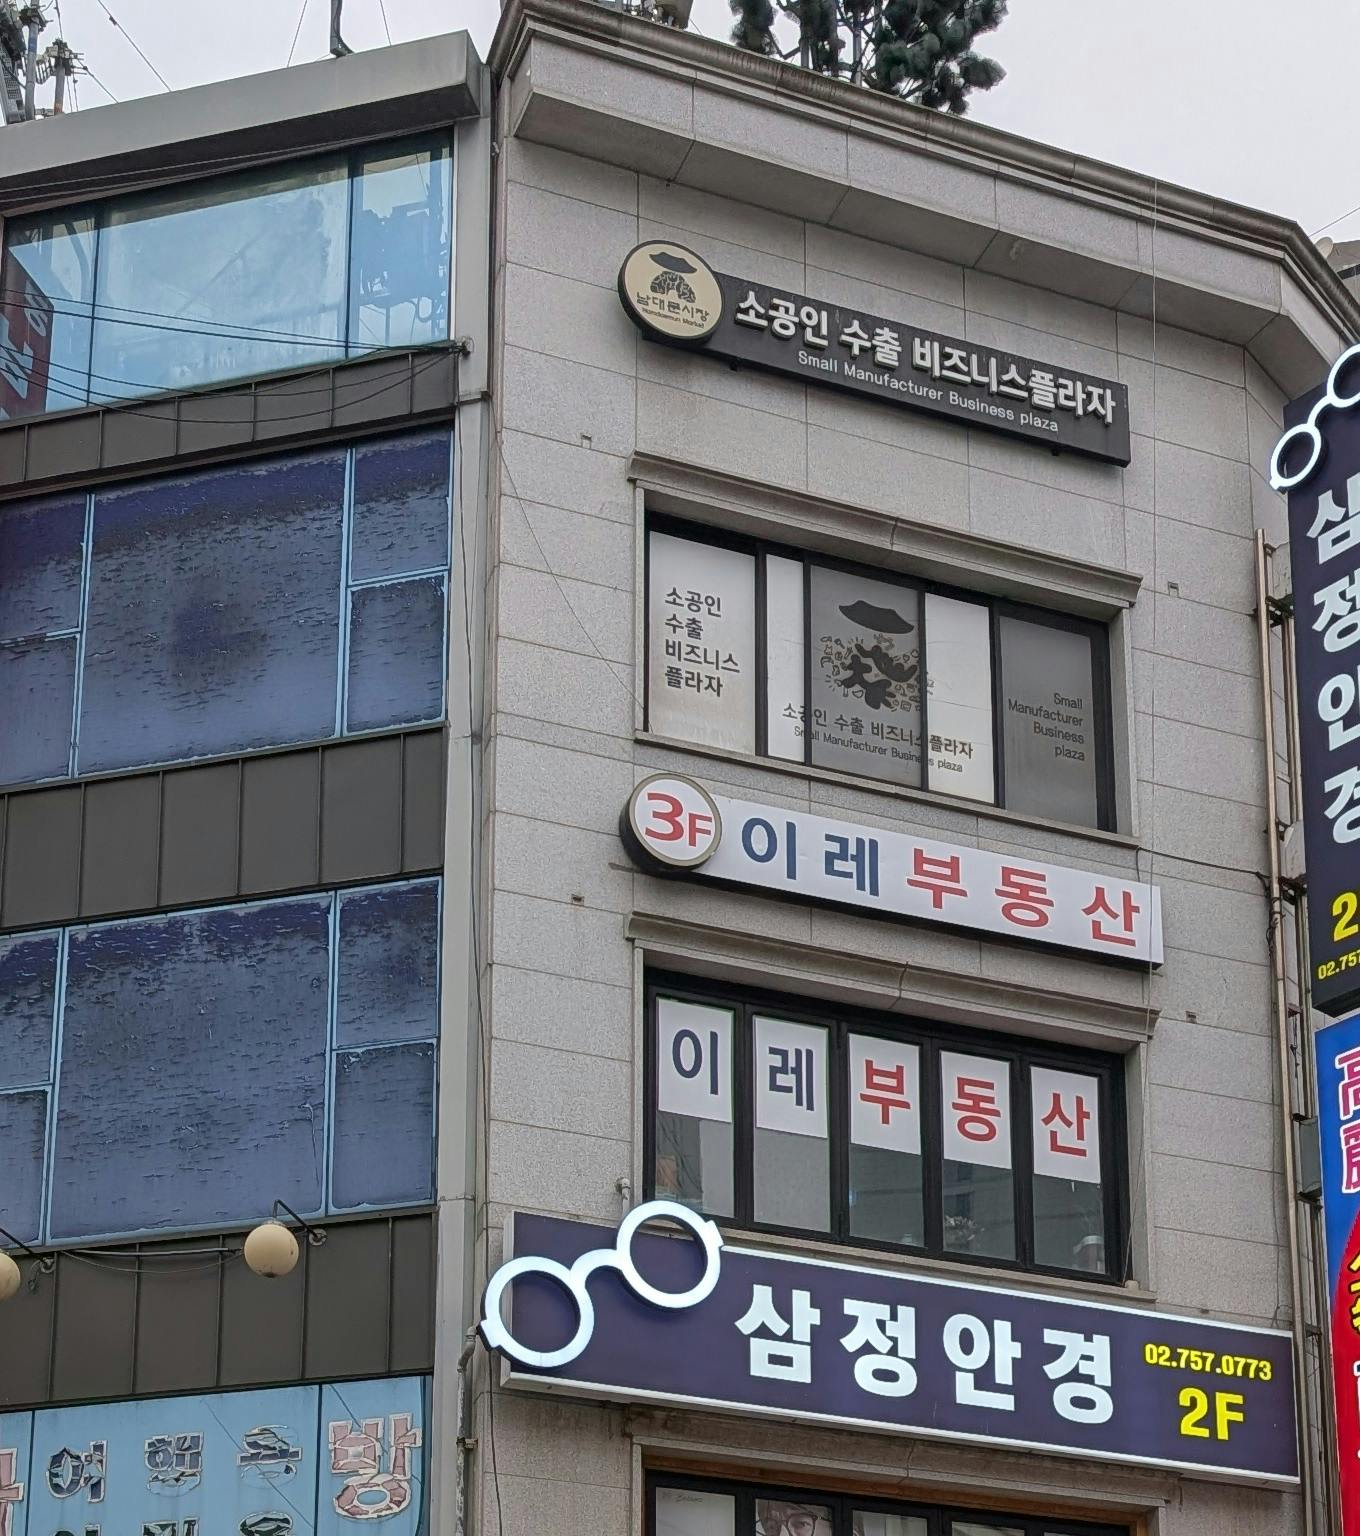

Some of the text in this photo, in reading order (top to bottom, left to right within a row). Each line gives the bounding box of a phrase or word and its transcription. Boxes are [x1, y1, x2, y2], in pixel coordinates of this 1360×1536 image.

[637, 292, 710, 322] 남대문시장
[736, 290, 1116, 424] 소공인 수출 비즈니스플라자
[797, 349, 1058, 434] Small Manufacturer Business plaza
[664, 586, 722, 619] 소공인
[664, 614, 705, 641] 수출
[664, 639, 742, 674] 비즈니스
[664, 665, 724, 698] 플라자
[1007, 698, 1084, 727] Manufacturer
[1053, 693, 1084, 710] Small
[834, 714, 864, 737] 수출
[1033, 721, 1085, 745] Business
[823, 732, 964, 774] Manufacturer Busines plaza
[1055, 744, 1086, 763] plaza
[643, 792, 714, 847] 3F
[741, 817, 1142, 948] 이레 부동산
[672, 1029, 1092, 1158] 이레 부동산
[734, 1283, 1116, 1426] 삼정안경
[1143, 1341, 1274, 1383] 02.757.0773
[1178, 1385, 1246, 1442] 2F
[327, 1412, 422, 1520] 방
